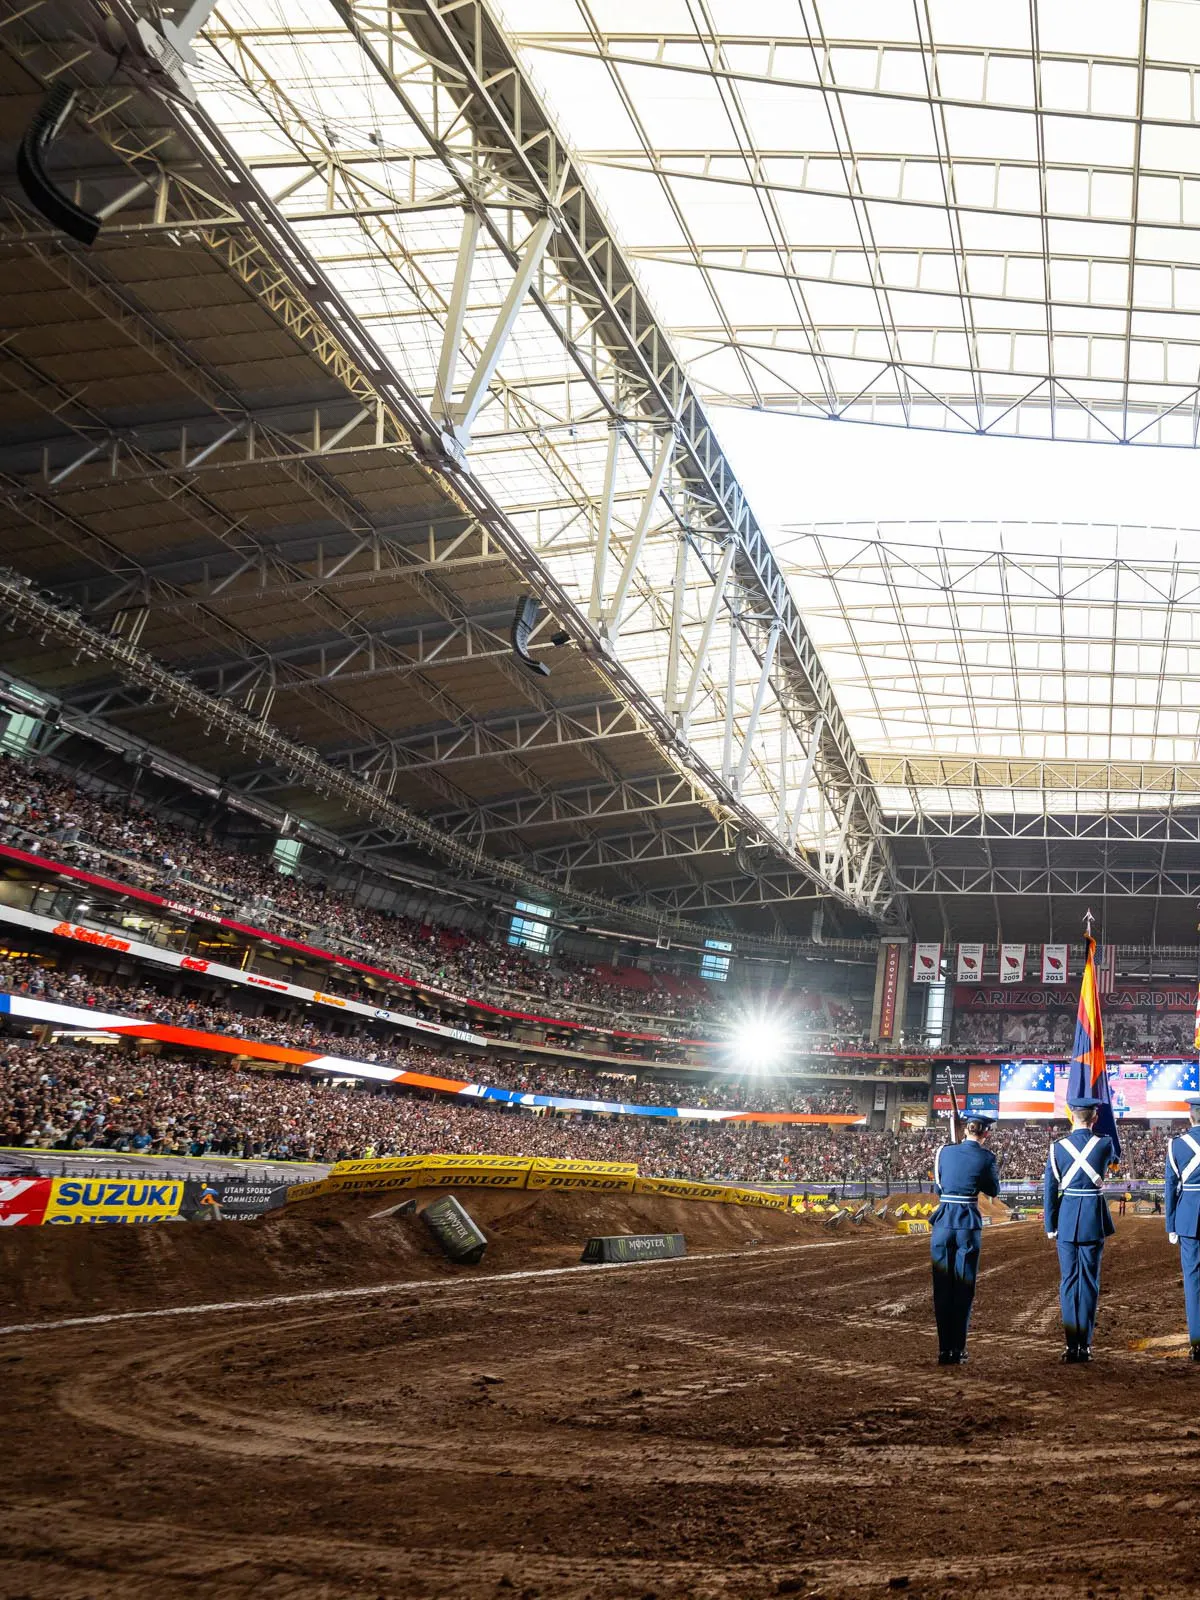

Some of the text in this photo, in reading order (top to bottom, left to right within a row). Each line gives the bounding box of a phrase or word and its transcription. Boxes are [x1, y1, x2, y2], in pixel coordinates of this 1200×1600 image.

[168, 901, 222, 923] LARRY WILSON
[886, 954, 896, 1006] FOOTBALL
[971, 991, 1079, 1006] ARIZONA
[346, 1160, 424, 1172] DUNLOP
[444, 1159, 529, 1168] DUNLOP
[553, 1163, 636, 1173] DUNLOP
[341, 1177, 412, 1191] DUNLOP
[439, 1176, 518, 1185] DUNLOP
[550, 1177, 629, 1189] DUNLOP
[56, 1182, 177, 1206] SUZUKI
[656, 1184, 722, 1198] DUNLOP
[741, 1193, 784, 1207] DUNLOP
[444, 1209, 468, 1239] MONSTER
[628, 1239, 665, 1249] MONSTER
